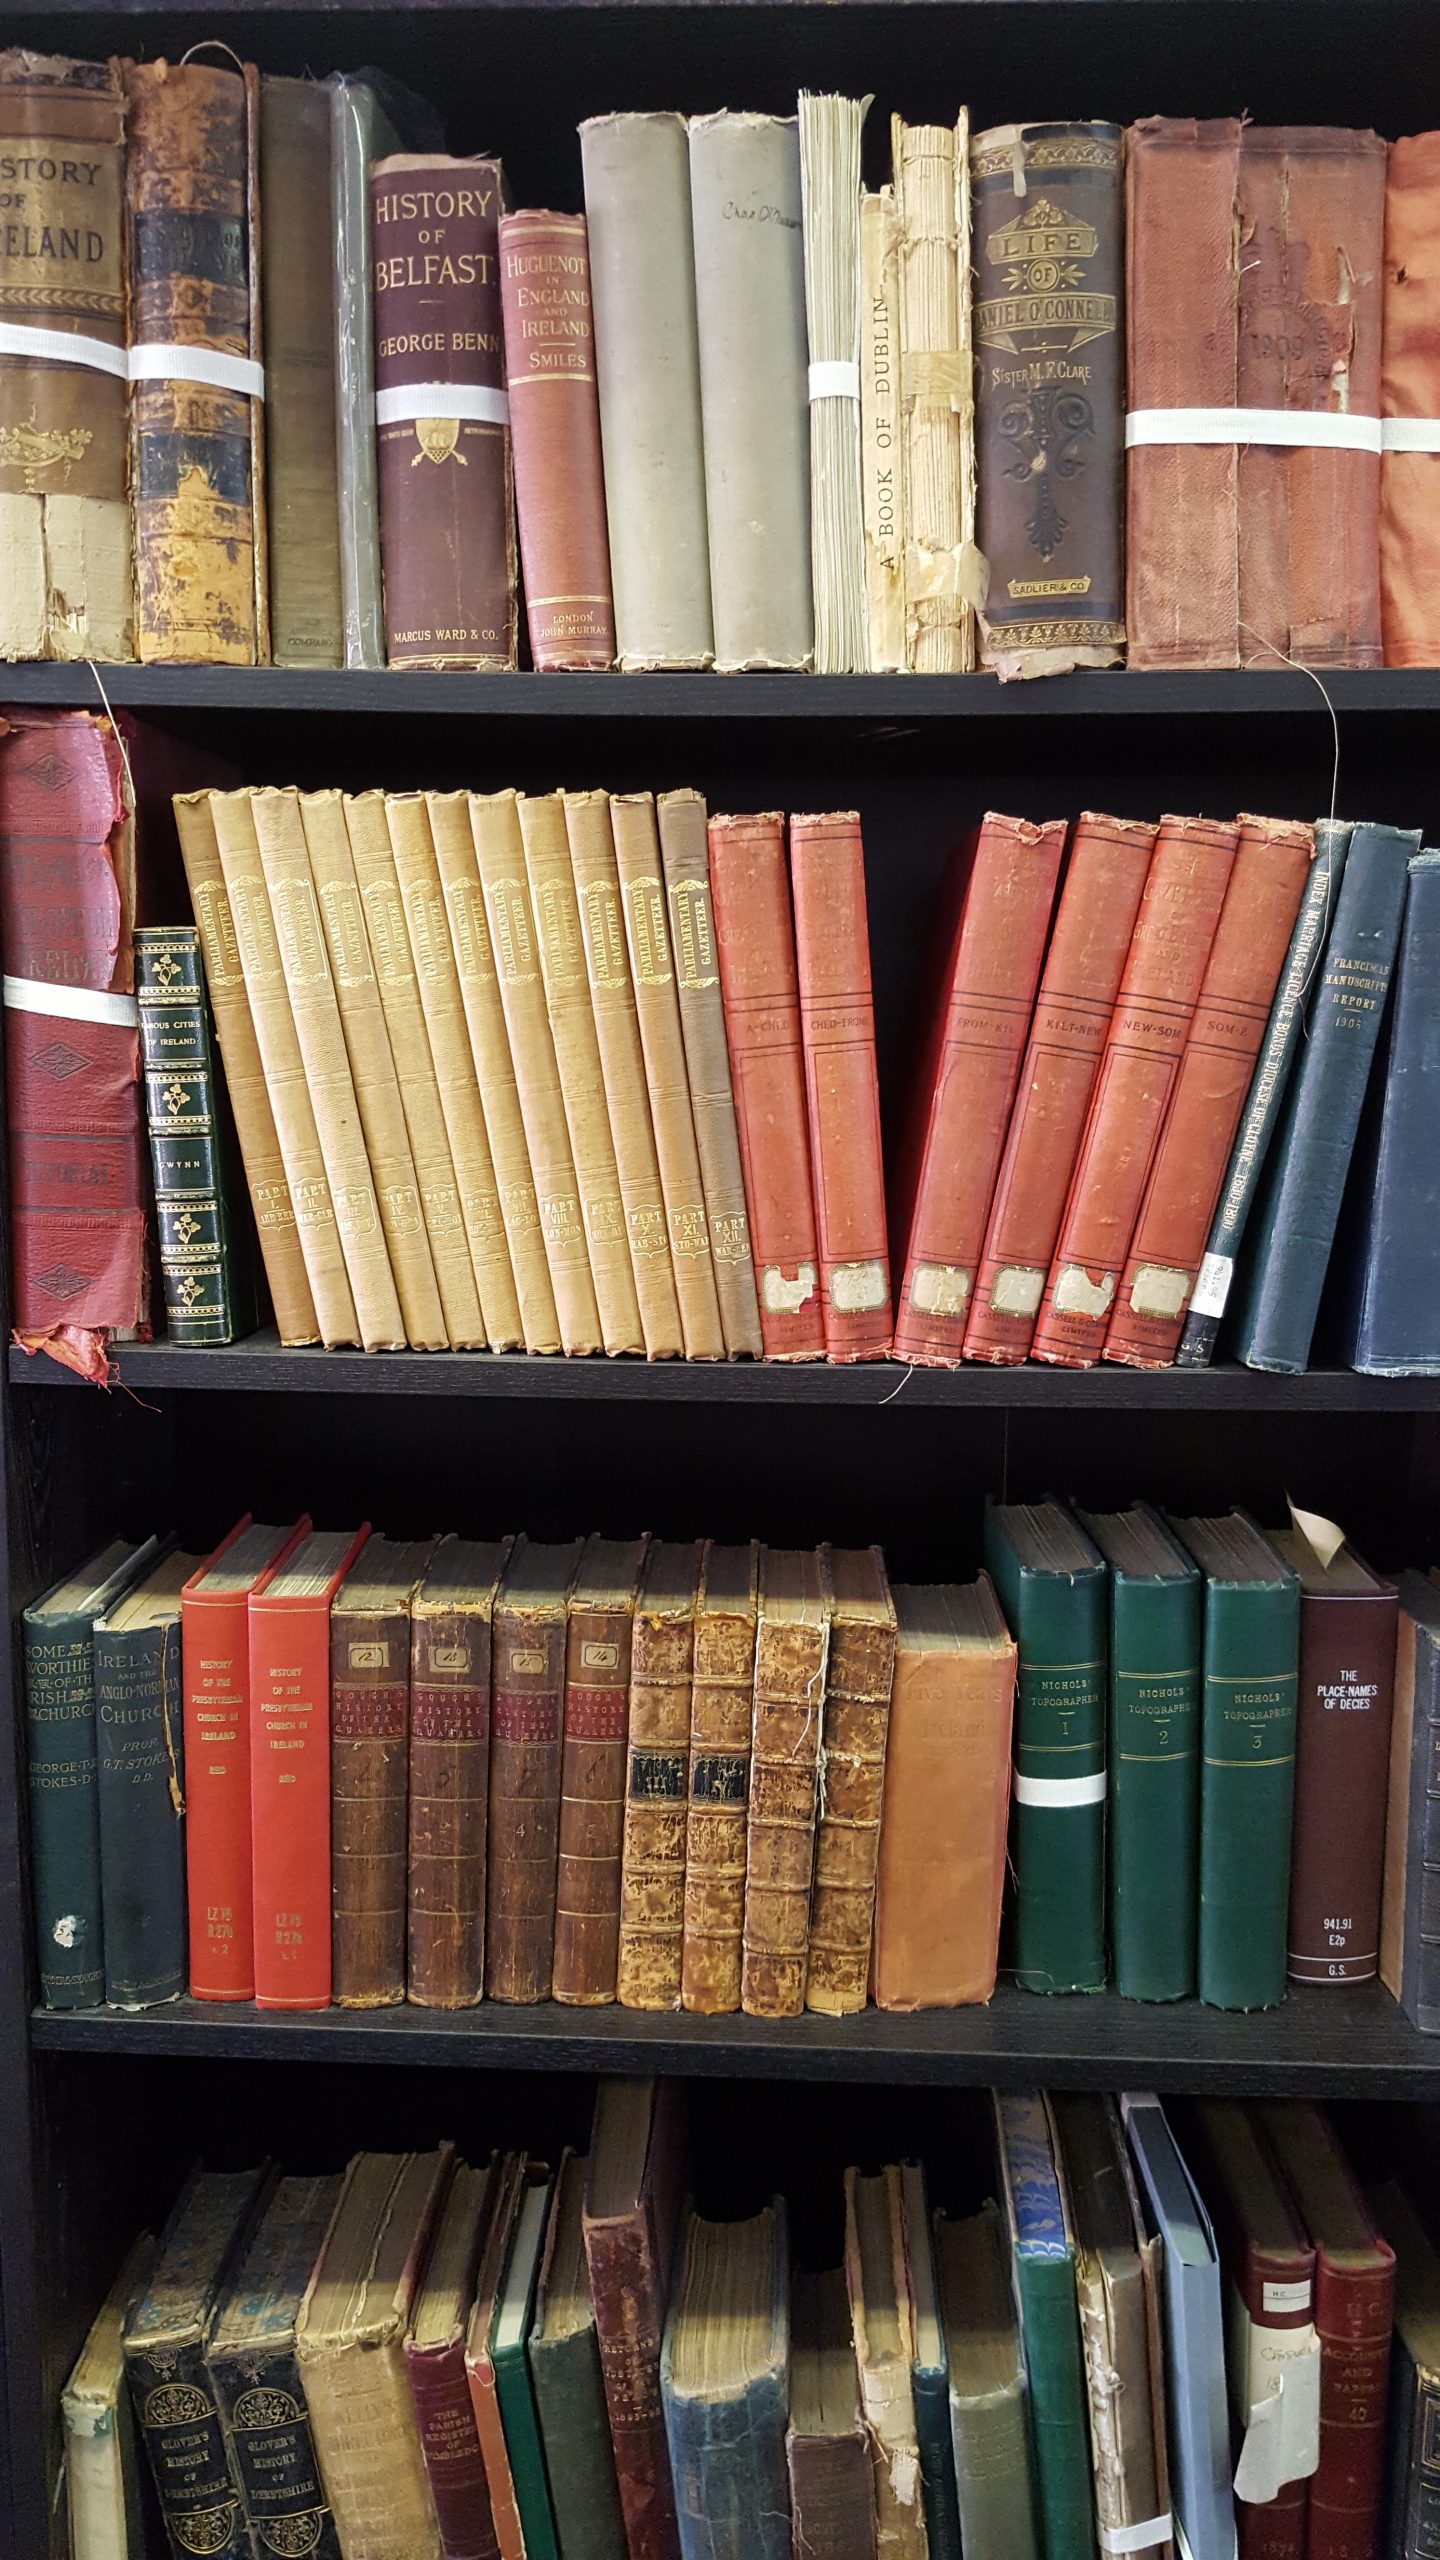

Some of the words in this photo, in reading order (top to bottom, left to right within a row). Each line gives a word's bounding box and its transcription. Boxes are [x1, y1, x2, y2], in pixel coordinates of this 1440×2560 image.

[0, 193, 27, 208] OF
[376, 190, 493, 225] HISTORY
[0, 225, 104, 263] ELAND
[418, 229, 446, 244] OF
[1002, 233, 1082, 257] LIFE
[546, 276, 560, 286] IN
[1034, 267, 1052, 283] OF
[518, 287, 590, 307] ENGLAND
[543, 307, 567, 317] AND
[976, 302, 1024, 330] DANIEL
[522, 319, 590, 339] IRELAND
[379, 333, 445, 358] GEORGE
[452, 332, 500, 351] BENN
[873, 298, 891, 396] DUBLIN
[529, 352, 587, 369] SMILES
[991, 366, 1028, 392] SISTER
[876, 417, 892, 449] OF
[878, 469, 894, 537] BOOK
[880, 556, 895, 570] A
[1013, 583, 1057, 595] SADLIER
[1060, 583, 1067, 592] &
[1070, 582, 1084, 591] CO
[552, 612, 594, 624] LONDON
[394, 630, 432, 643] MARCUS
[436, 629, 467, 641] WARD
[470, 629, 480, 641] &
[482, 628, 499, 641] CO.
[539, 625, 566, 638] JOHN
[1308, 870, 1330, 904] INDEX
[198, 893, 226, 978] PARLIAMENTARY
[587, 894, 610, 980] PARLIAMENTARY
[632, 888, 653, 979] PARLIAMENTARY
[677, 893, 697, 979] PARLIAMENTARY
[1334, 956, 1391, 976] FRANCISCAN
[1325, 974, 1389, 994] MANUSCRIPTS
[1332, 993, 1377, 1010] REPORT
[141, 1022, 170, 1030] FAMOUS
[173, 1021, 201, 1029] CITIES
[1122, 1020, 1183, 1039] NEW-SOM
[148, 1038, 157, 1046] OF
[160, 1037, 197, 1046] IRELAND
[1269, 1022, 1292, 1057] BONDS
[1256, 1061, 1280, 1105] DIOCESE
[257, 1186, 289, 1200] PART
[296, 1183, 328, 1199] PART
[1222, 1174, 1248, 1232] 1630-1800
[631, 1211, 662, 1226] PART
[674, 1211, 705, 1226] PART
[715, 1217, 745, 1233] PART
[26, 1645, 66, 1660] SOME
[358, 1652, 376, 1662] 12
[1340, 1670, 1358, 1682] THE
[1317, 1684, 1378, 1697] PLACE-NAMES
[1031, 1693, 1099, 1706] TOPOGRAPHER
[1324, 1698, 1336, 1710] OF
[1338, 1698, 1371, 1710] DECIES
[100, 1699, 180, 1724] CHURCH
[1223, 1707, 1293, 1721] TOPOGRAPHER
[1061, 1722, 1070, 1735] 1
[1158, 1730, 1169, 1745] 2
[1252, 1735, 1263, 1749] 3
[30, 1762, 77, 1774] GEORGE
[30, 1775, 77, 1788] STOKES
[1323, 1918, 1352, 1931] 941.91
[1329, 1934, 1346, 1949] E2p
[1328, 1965, 1347, 1977] G.S.
[161, 2431, 210, 2450] GLOVER'S
[248, 2434, 296, 2452] GLOVER'S
[166, 2450, 210, 2468] HISTORY
[252, 2452, 296, 2469] HISTORY
